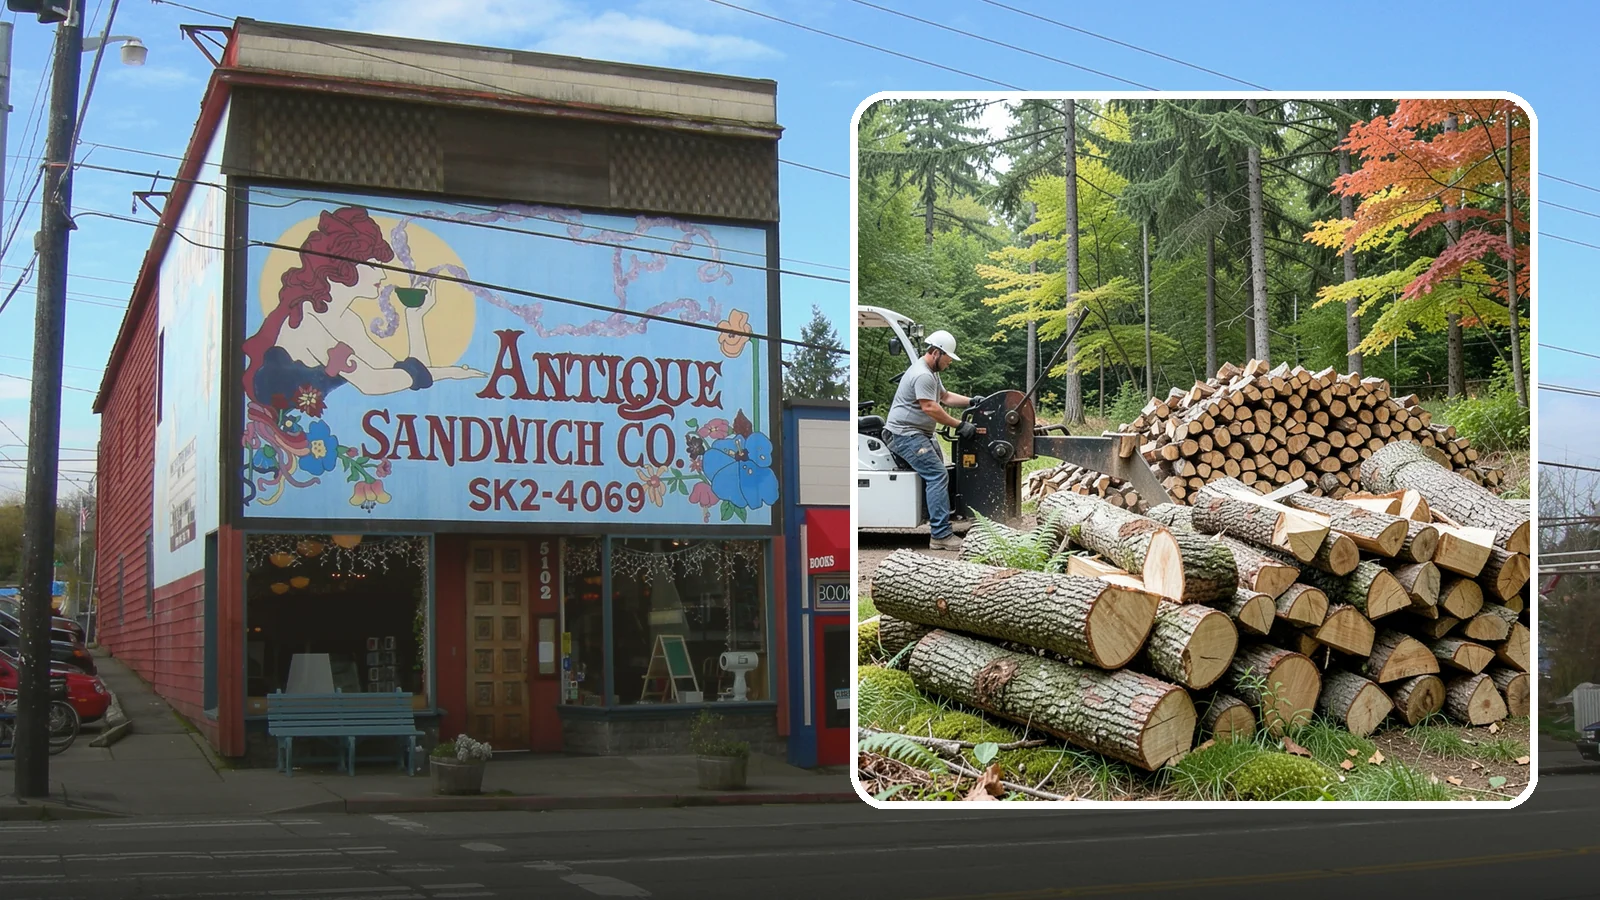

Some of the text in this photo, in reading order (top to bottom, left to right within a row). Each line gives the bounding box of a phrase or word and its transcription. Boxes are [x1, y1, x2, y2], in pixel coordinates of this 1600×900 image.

[476, 329, 724, 421] ANTIQUE
[362, 408, 685, 469] SANDWICH CO.
[468, 477, 646, 513] SK2-4069
[540, 542, 552, 599] 5102
[809, 555, 834, 569] BOOKS
